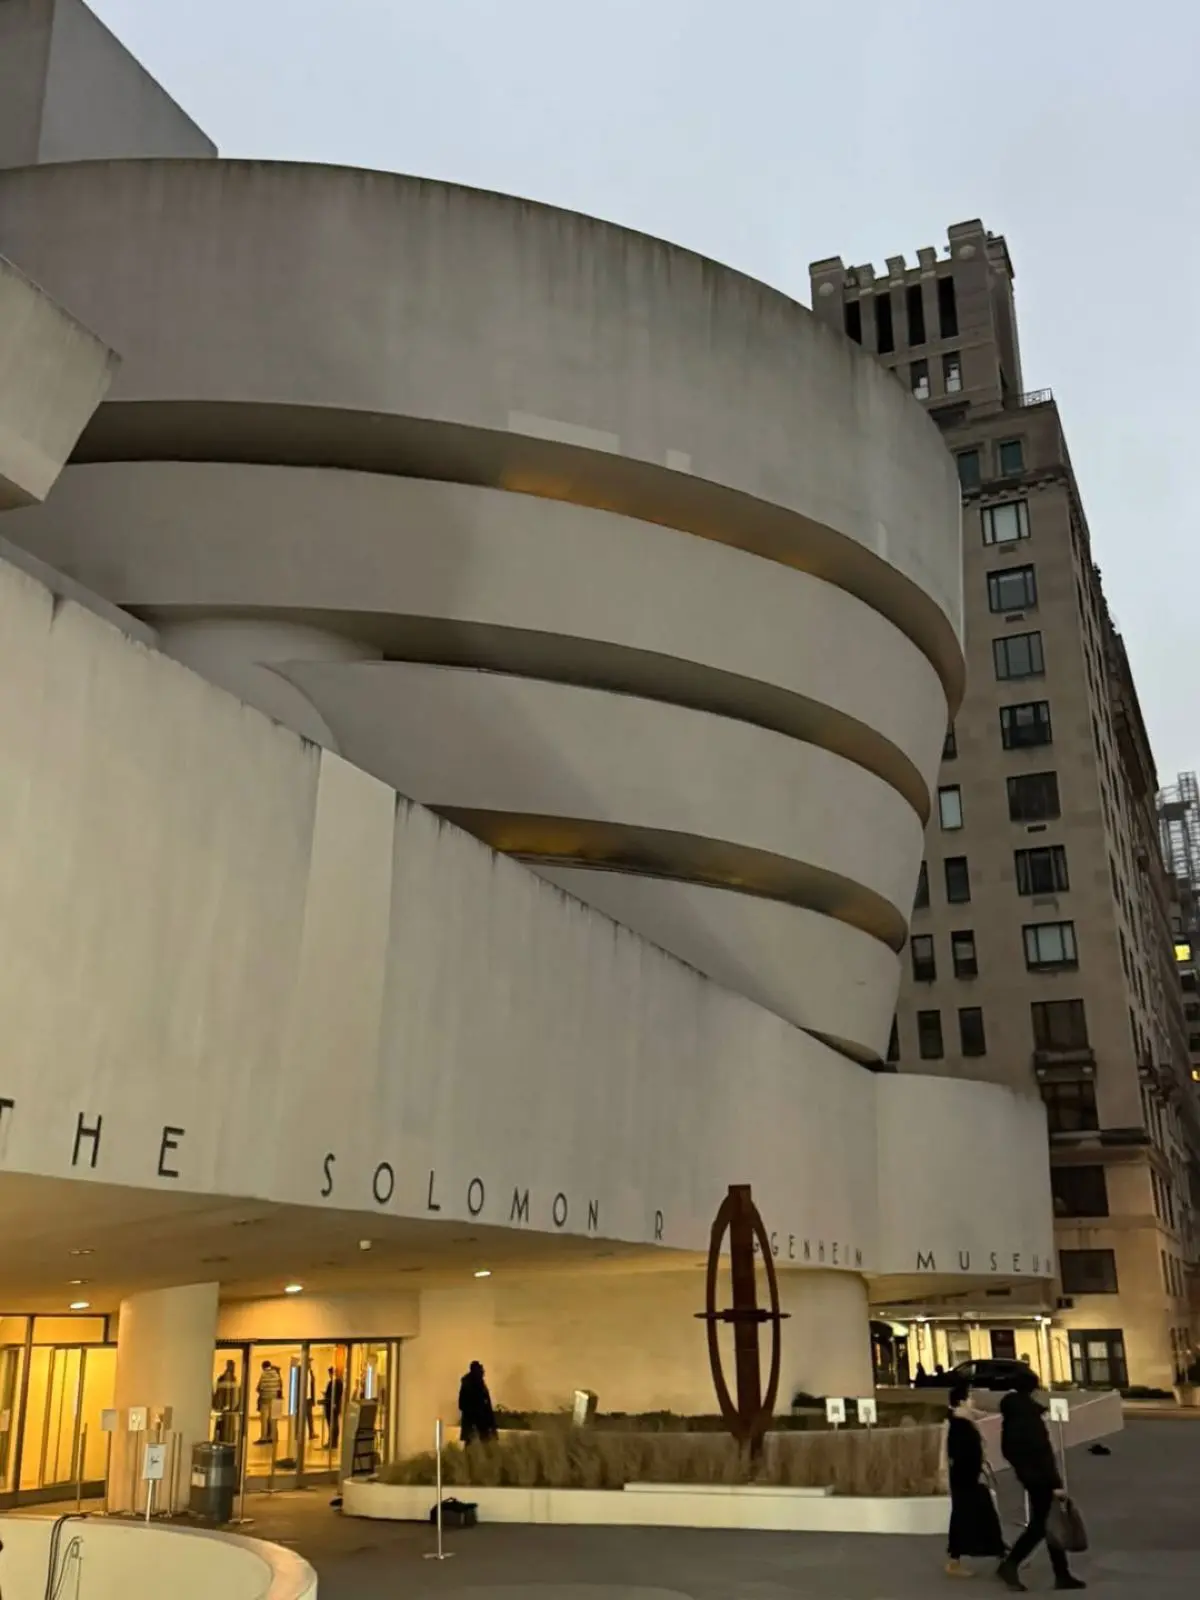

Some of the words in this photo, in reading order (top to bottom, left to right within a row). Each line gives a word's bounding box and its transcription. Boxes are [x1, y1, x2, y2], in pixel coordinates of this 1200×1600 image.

[320, 1153, 600, 1231] SOLOMON
[655, 1210, 664, 1241] R
[752, 1231, 863, 1266] GENHEIM
